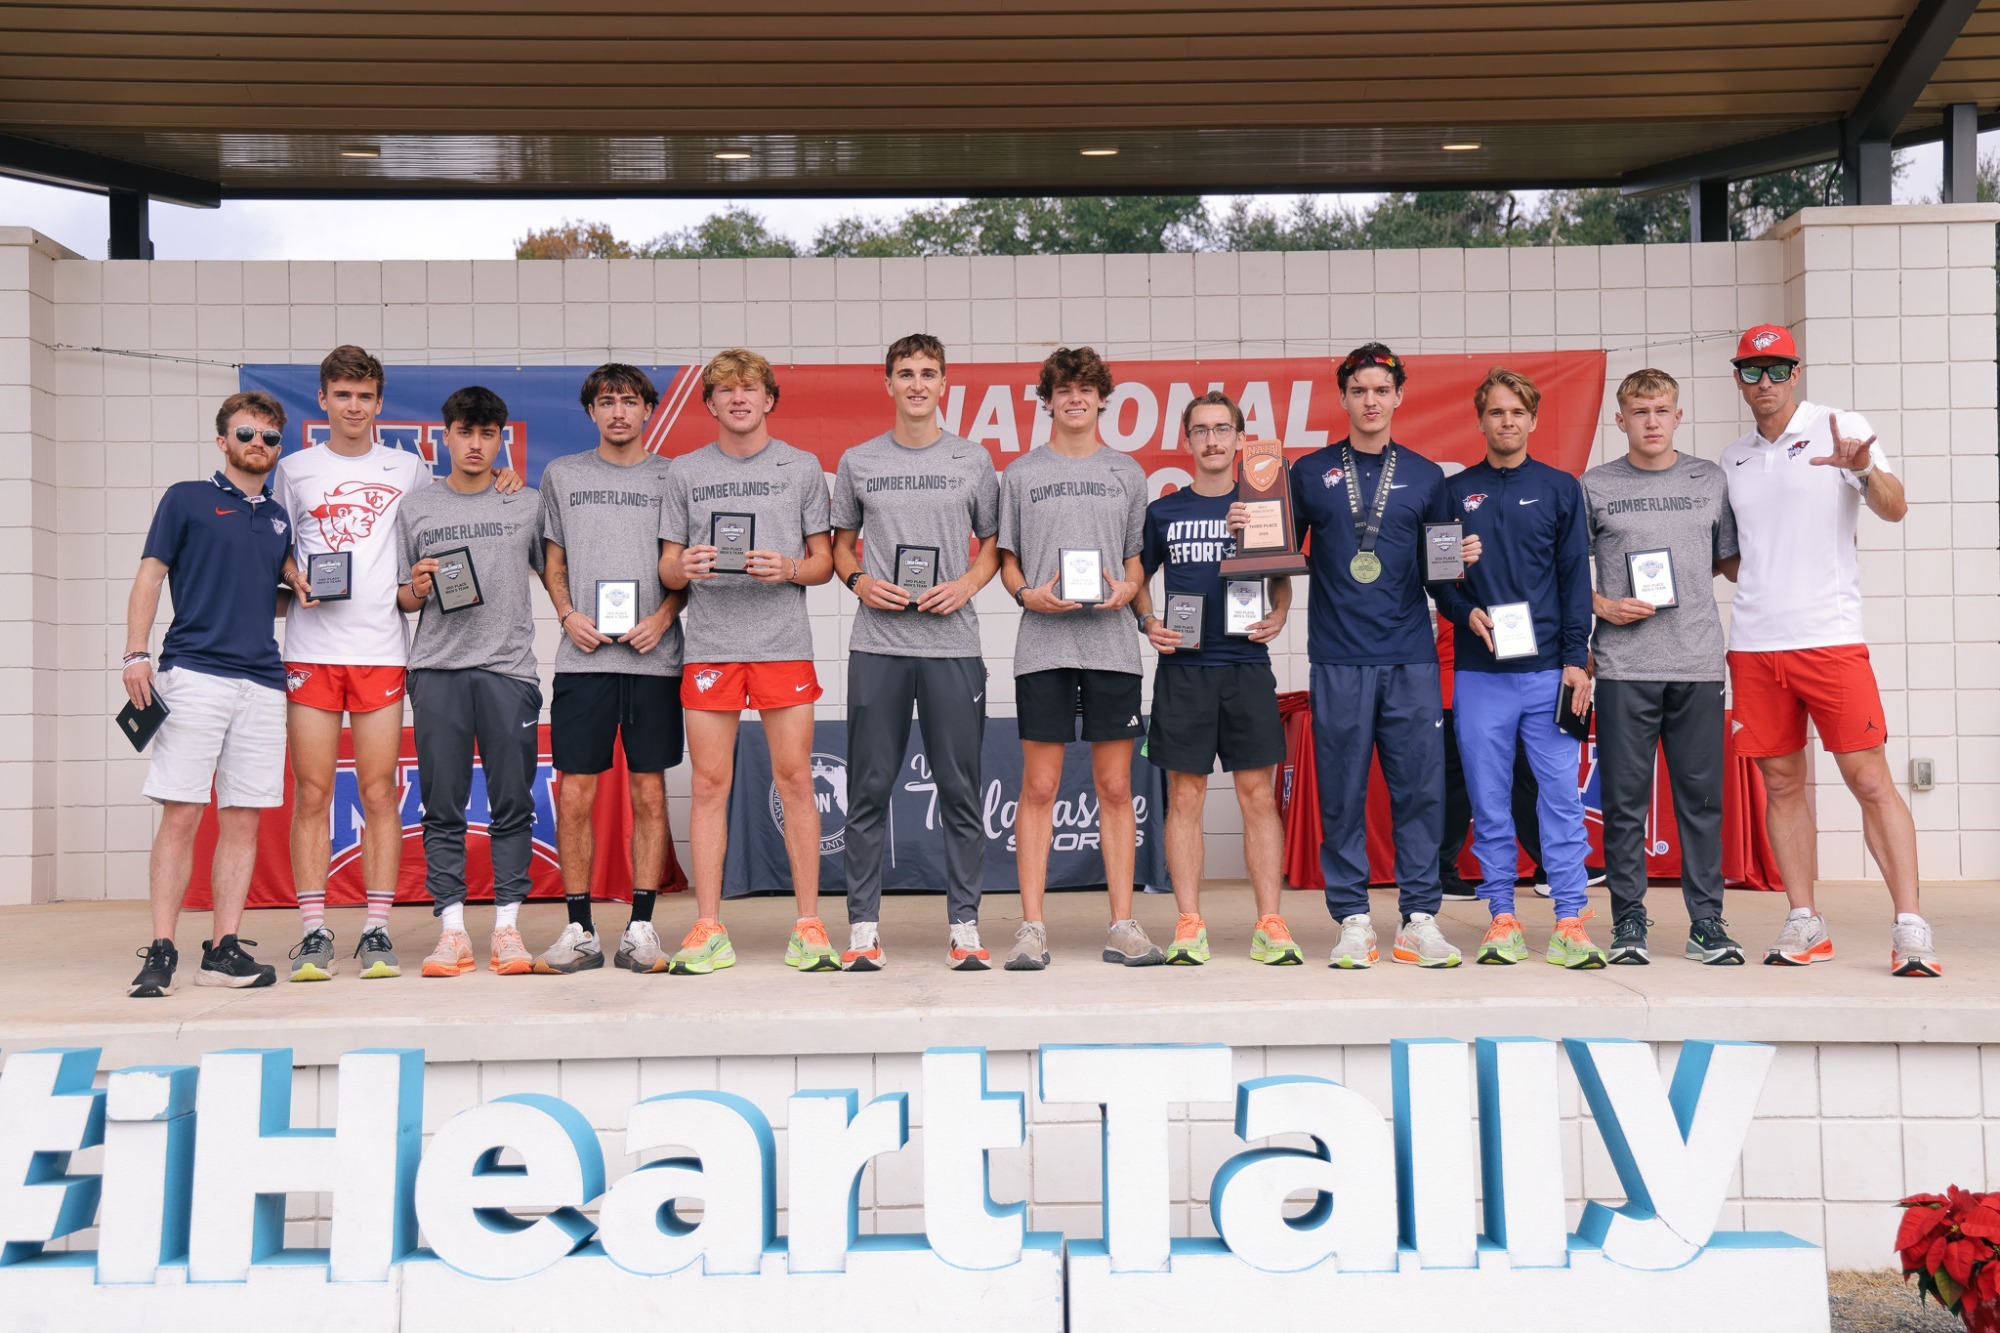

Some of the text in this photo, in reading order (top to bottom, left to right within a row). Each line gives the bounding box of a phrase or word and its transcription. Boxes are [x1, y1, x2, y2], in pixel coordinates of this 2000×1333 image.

[692, 481, 770, 502] CUMBERLANDS
[866, 475, 947, 493] CUMBERLANDS
[1030, 481, 1106, 503] CUMBERLANDS
[569, 490, 648, 507] CUMBERLANDS
[1607, 496, 1692, 515] CUMBERLANDS
[423, 522, 504, 546] CUMBERLANDS
[1168, 541, 1224, 564] EFFORT
[820, 836, 845, 851] UNTY
